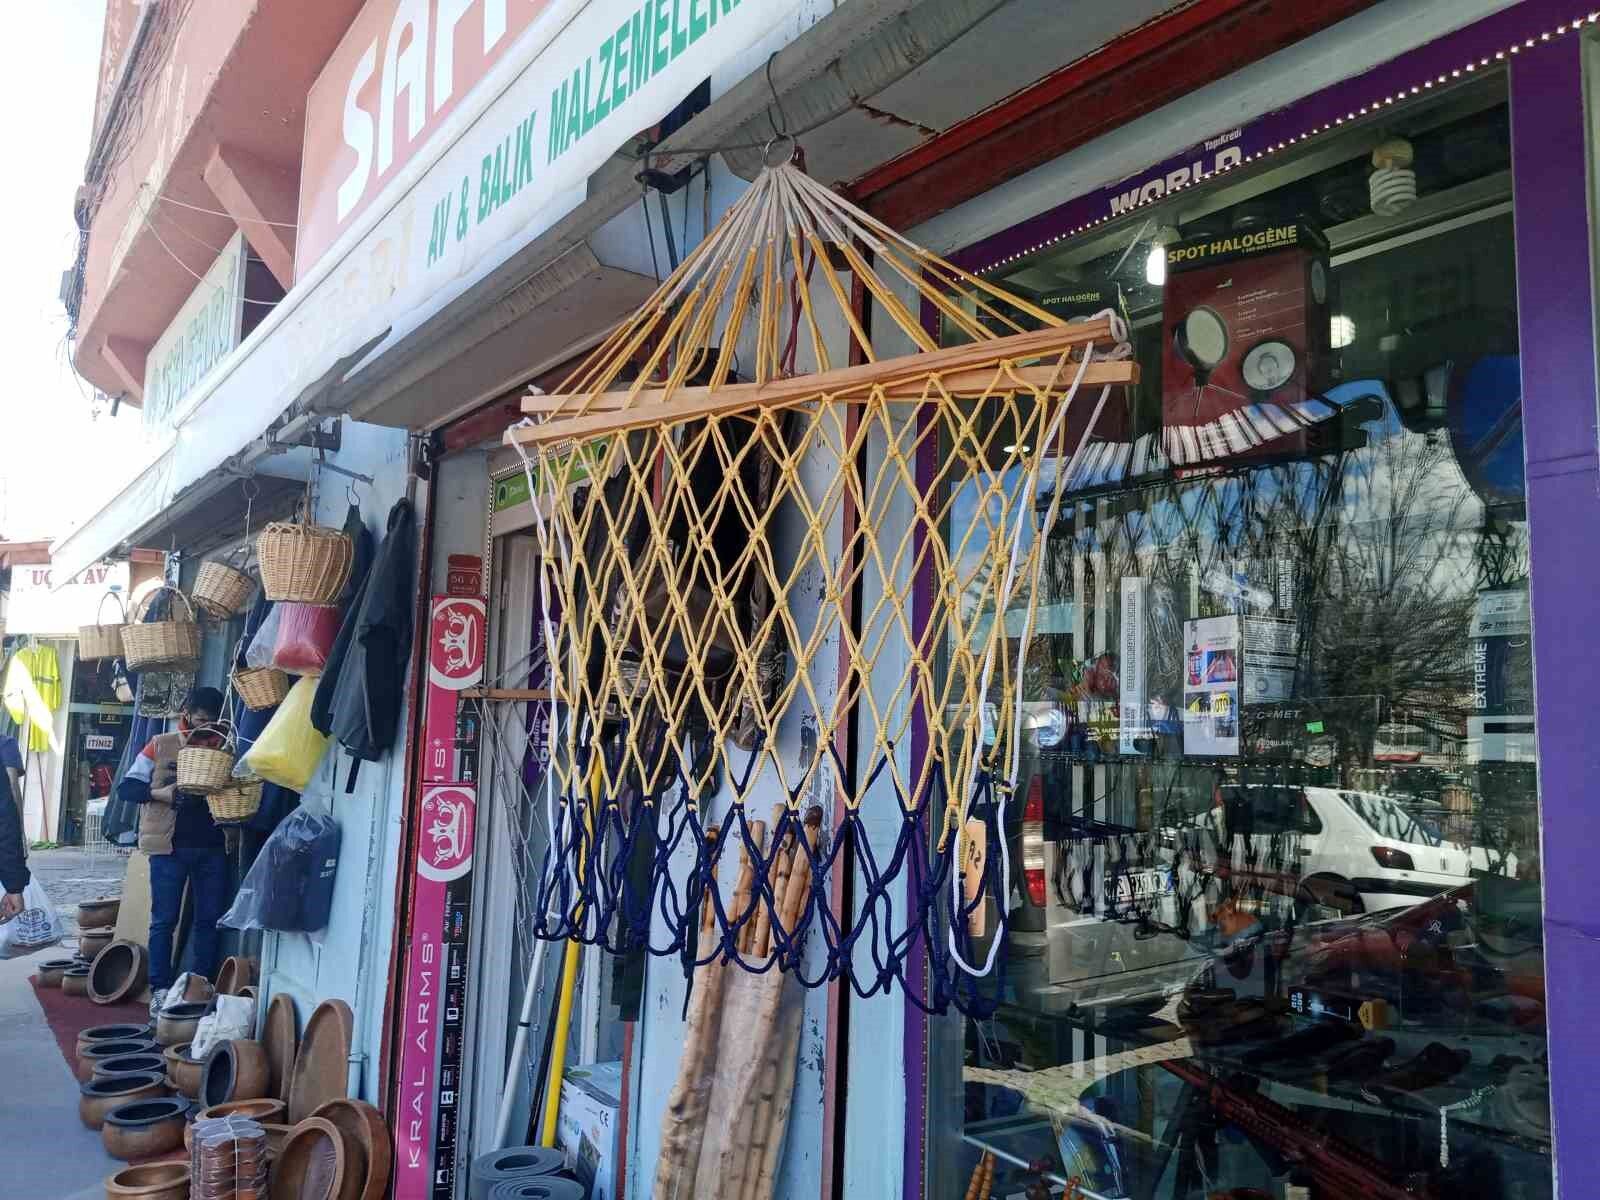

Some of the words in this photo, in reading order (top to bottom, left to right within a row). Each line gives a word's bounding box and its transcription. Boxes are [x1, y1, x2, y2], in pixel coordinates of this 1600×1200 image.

[427, 191, 452, 269] AV
[456, 174, 469, 243] &
[477, 110, 537, 224] BALIK
[548, 0, 742, 165] MALZEMELE
[1167, 244, 1208, 264] SPOT
[1210, 224, 1297, 255] HALOGÈNE
[83, 567, 109, 584] AV
[1475, 642, 1488, 709] EXTREME
[416, 943, 434, 1053] ARMS
[408, 1066, 426, 1169] KRAL
